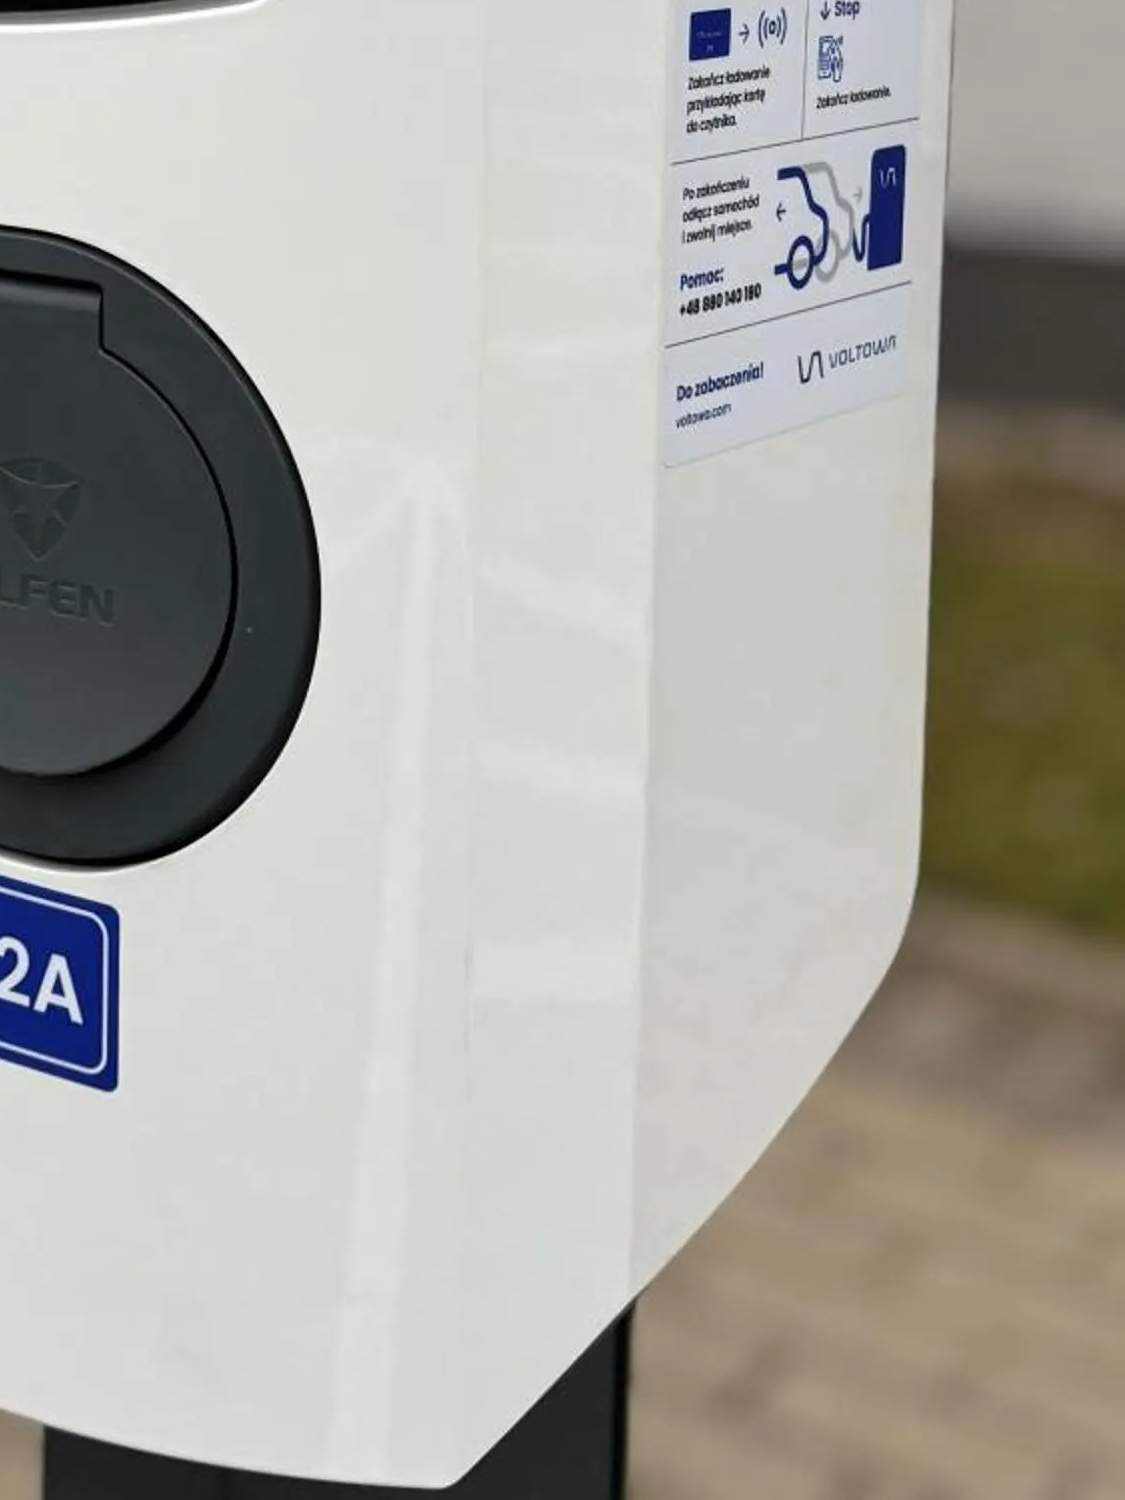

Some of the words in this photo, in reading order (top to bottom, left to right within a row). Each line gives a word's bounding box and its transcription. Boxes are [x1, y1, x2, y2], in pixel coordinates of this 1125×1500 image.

[834, 0, 860, 21] Stop
[683, 187, 695, 200] Po
[680, 268, 724, 291] Pomoc:
[680, 297, 700, 316] +48
[676, 384, 694, 402] Do
[694, 361, 765, 398] zobaczenia!
